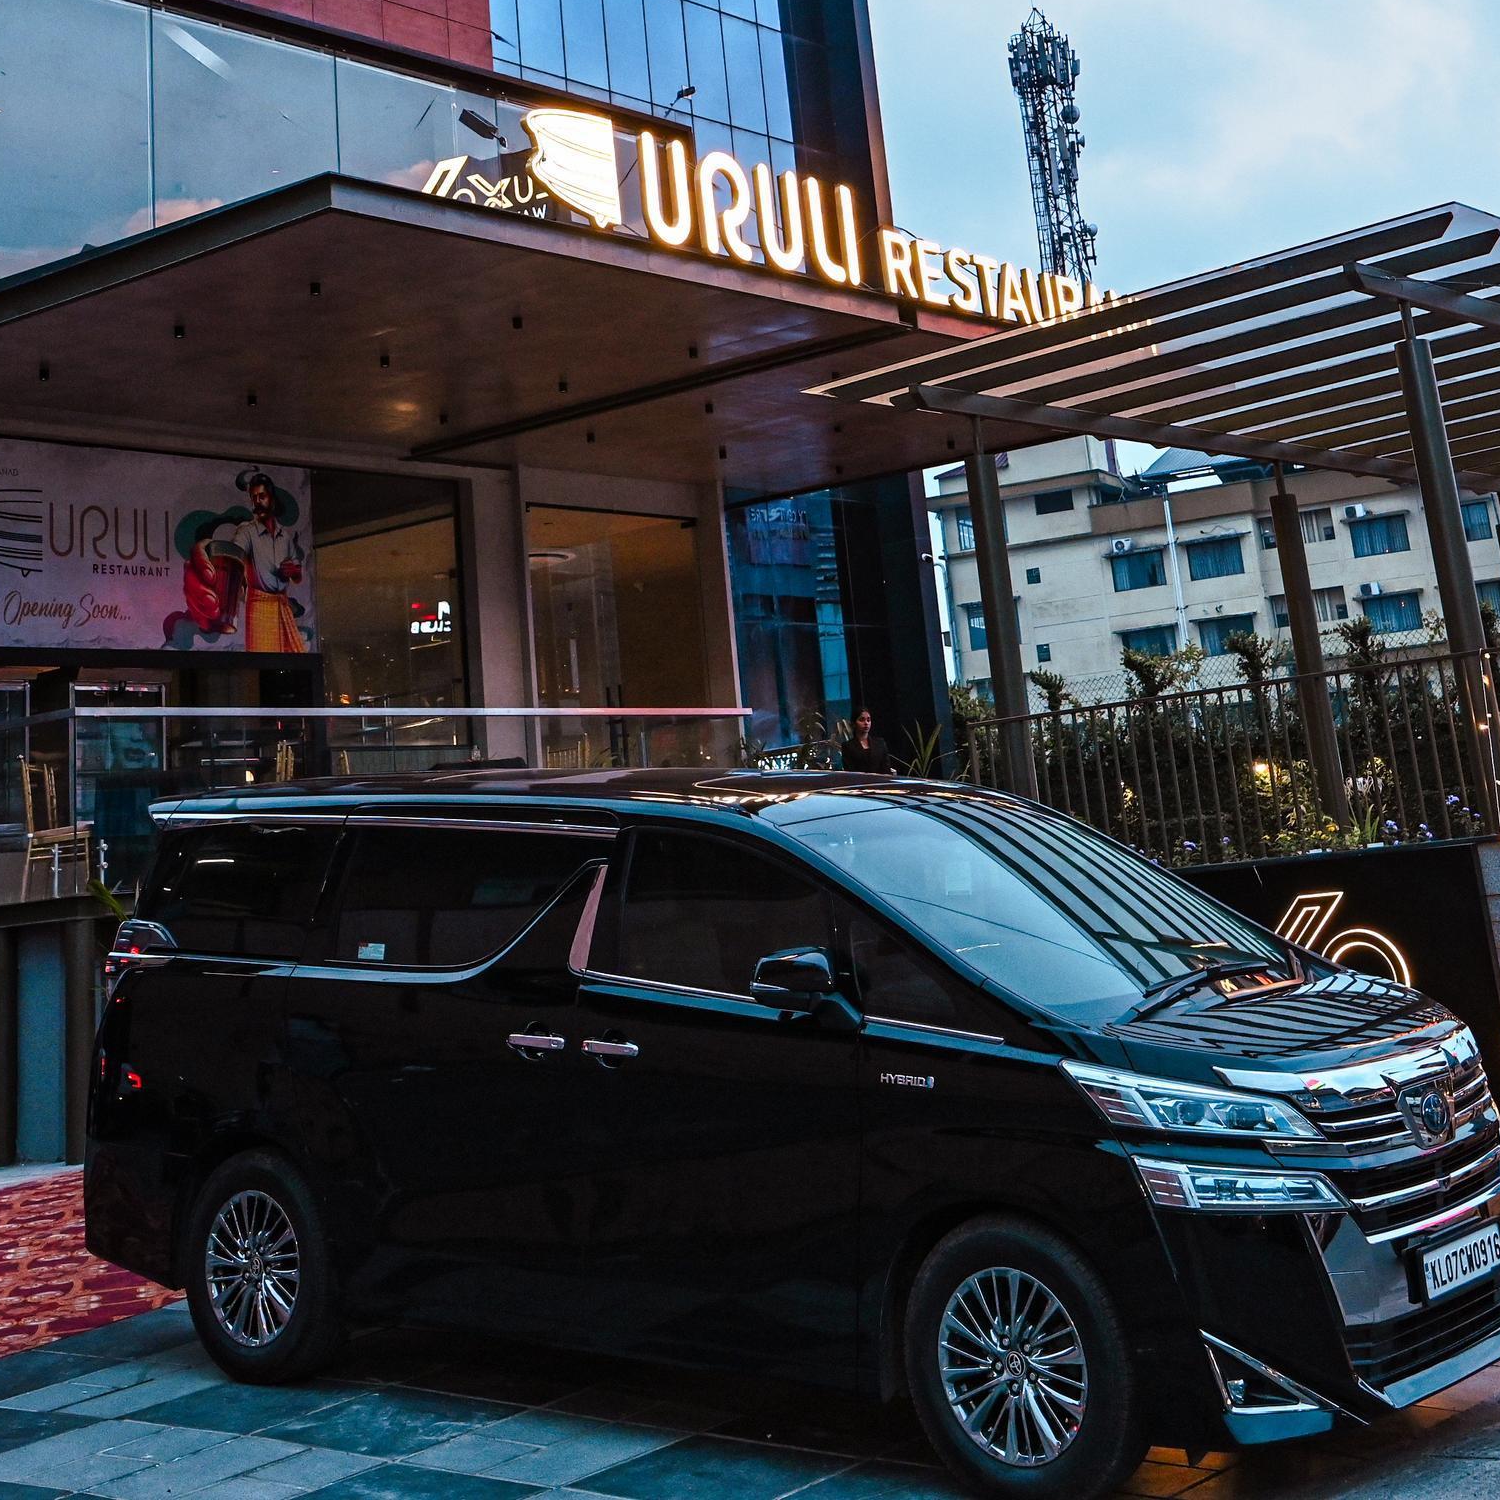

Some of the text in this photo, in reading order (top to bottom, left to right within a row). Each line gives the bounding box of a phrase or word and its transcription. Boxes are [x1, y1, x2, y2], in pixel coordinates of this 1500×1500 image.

[637, 129, 862, 287] URULI
[49, 502, 170, 562] URULI
[92, 563, 171, 577] RESTAURANT
[3, 590, 76, 629] Opening
[880, 1073, 926, 1087] HYBRID
